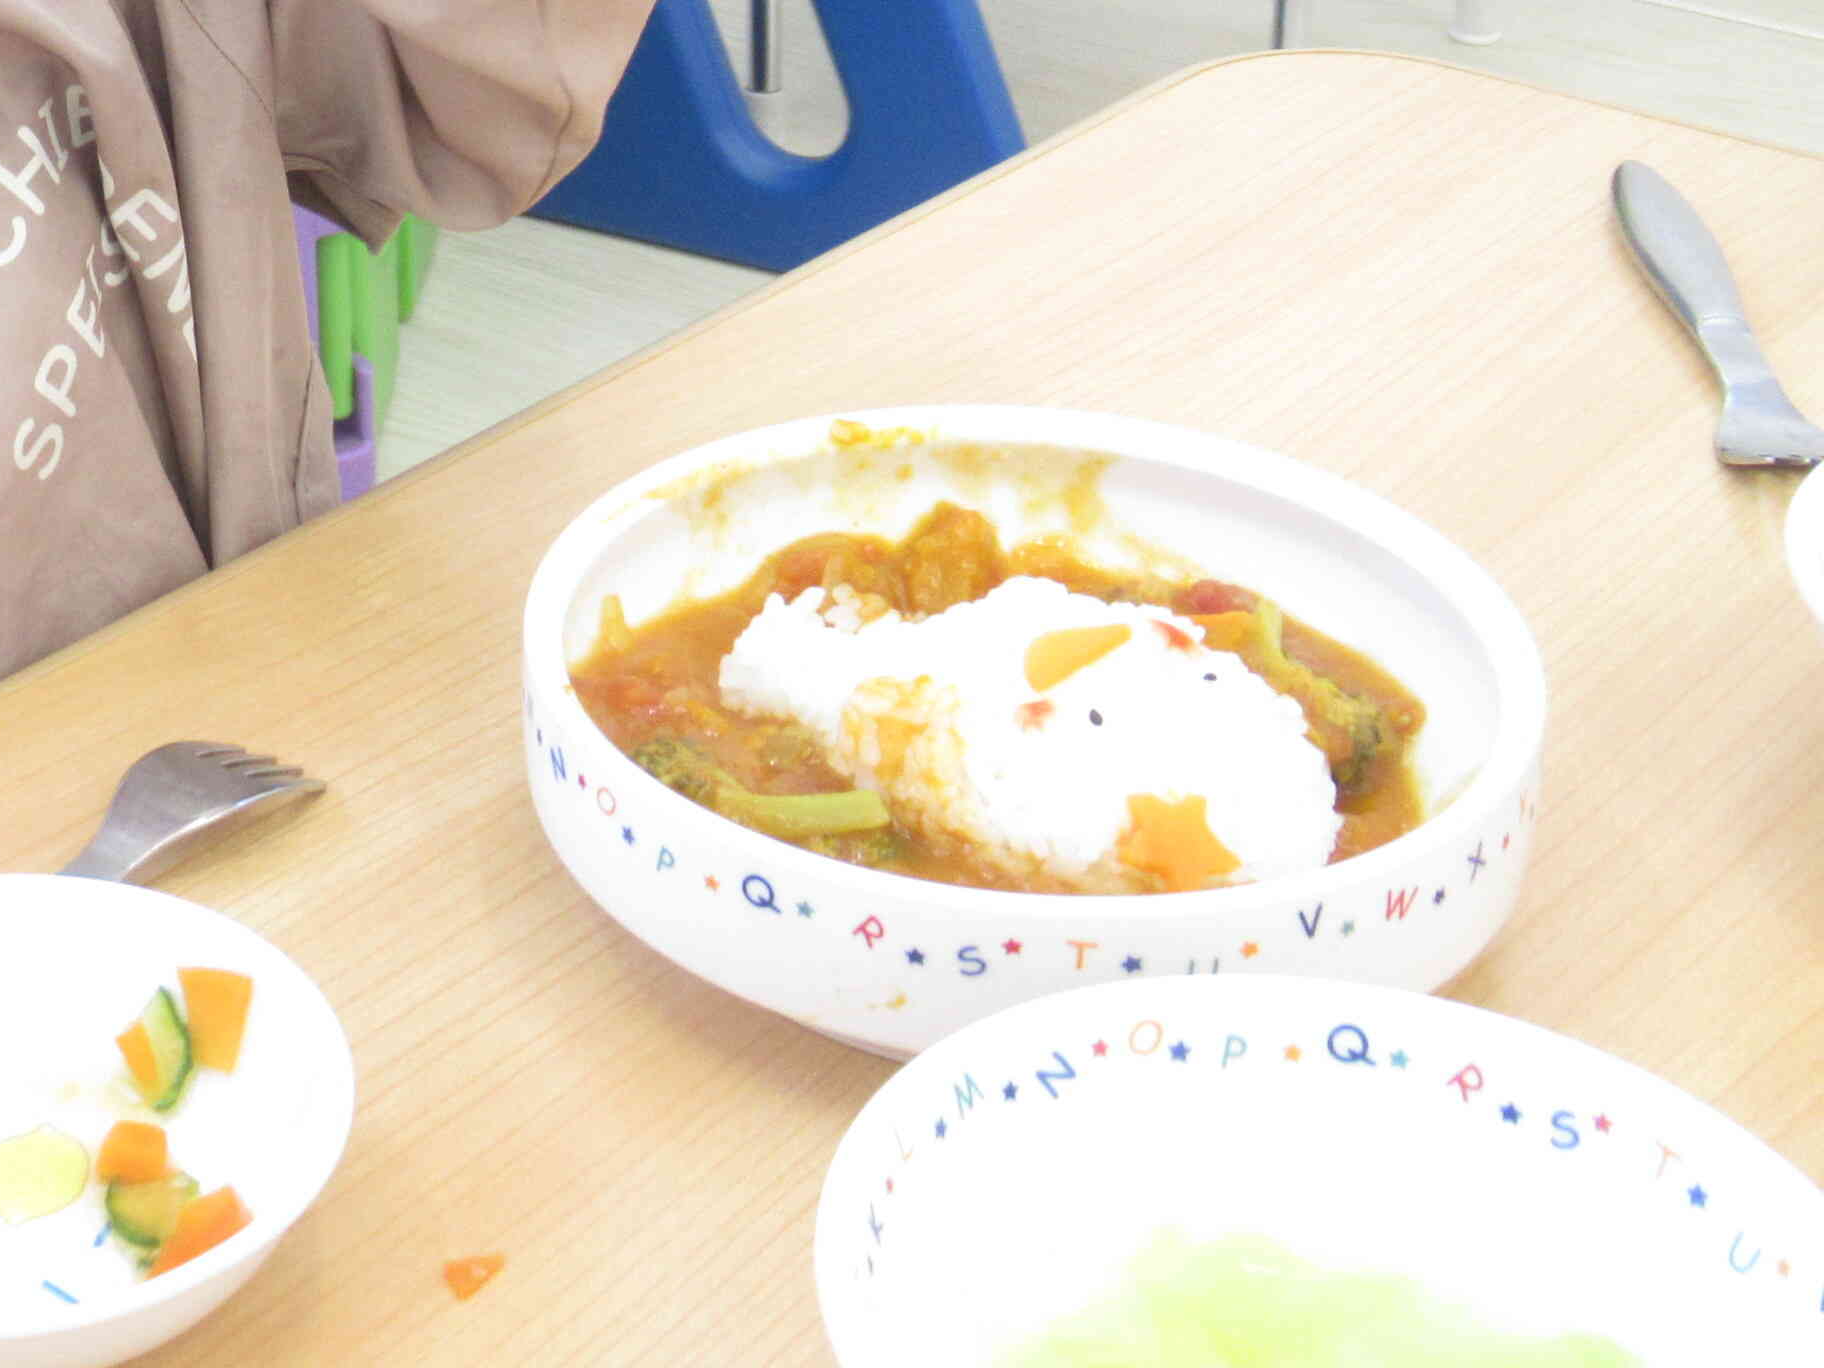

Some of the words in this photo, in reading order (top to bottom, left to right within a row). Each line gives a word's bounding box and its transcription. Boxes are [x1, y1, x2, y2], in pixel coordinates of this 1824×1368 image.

[596, 787, 616, 816] O
[657, 845, 675, 872] P
[742, 875, 781, 914] Q
[853, 915, 885, 948] R
[957, 946, 987, 976] S
[1067, 940, 1098, 970] T
[1298, 903, 1323, 938] V
[1385, 885, 1418, 920] W
[954, 1072, 984, 1119] M
[1036, 1052, 1076, 1098] N
[1128, 1020, 1163, 1055] O
[1220, 1034, 1246, 1068] P
[1327, 1024, 1376, 1066] Q
[1447, 1064, 1484, 1101] R
[1550, 1110, 1580, 1149] S
[1728, 1230, 1761, 1272] U
